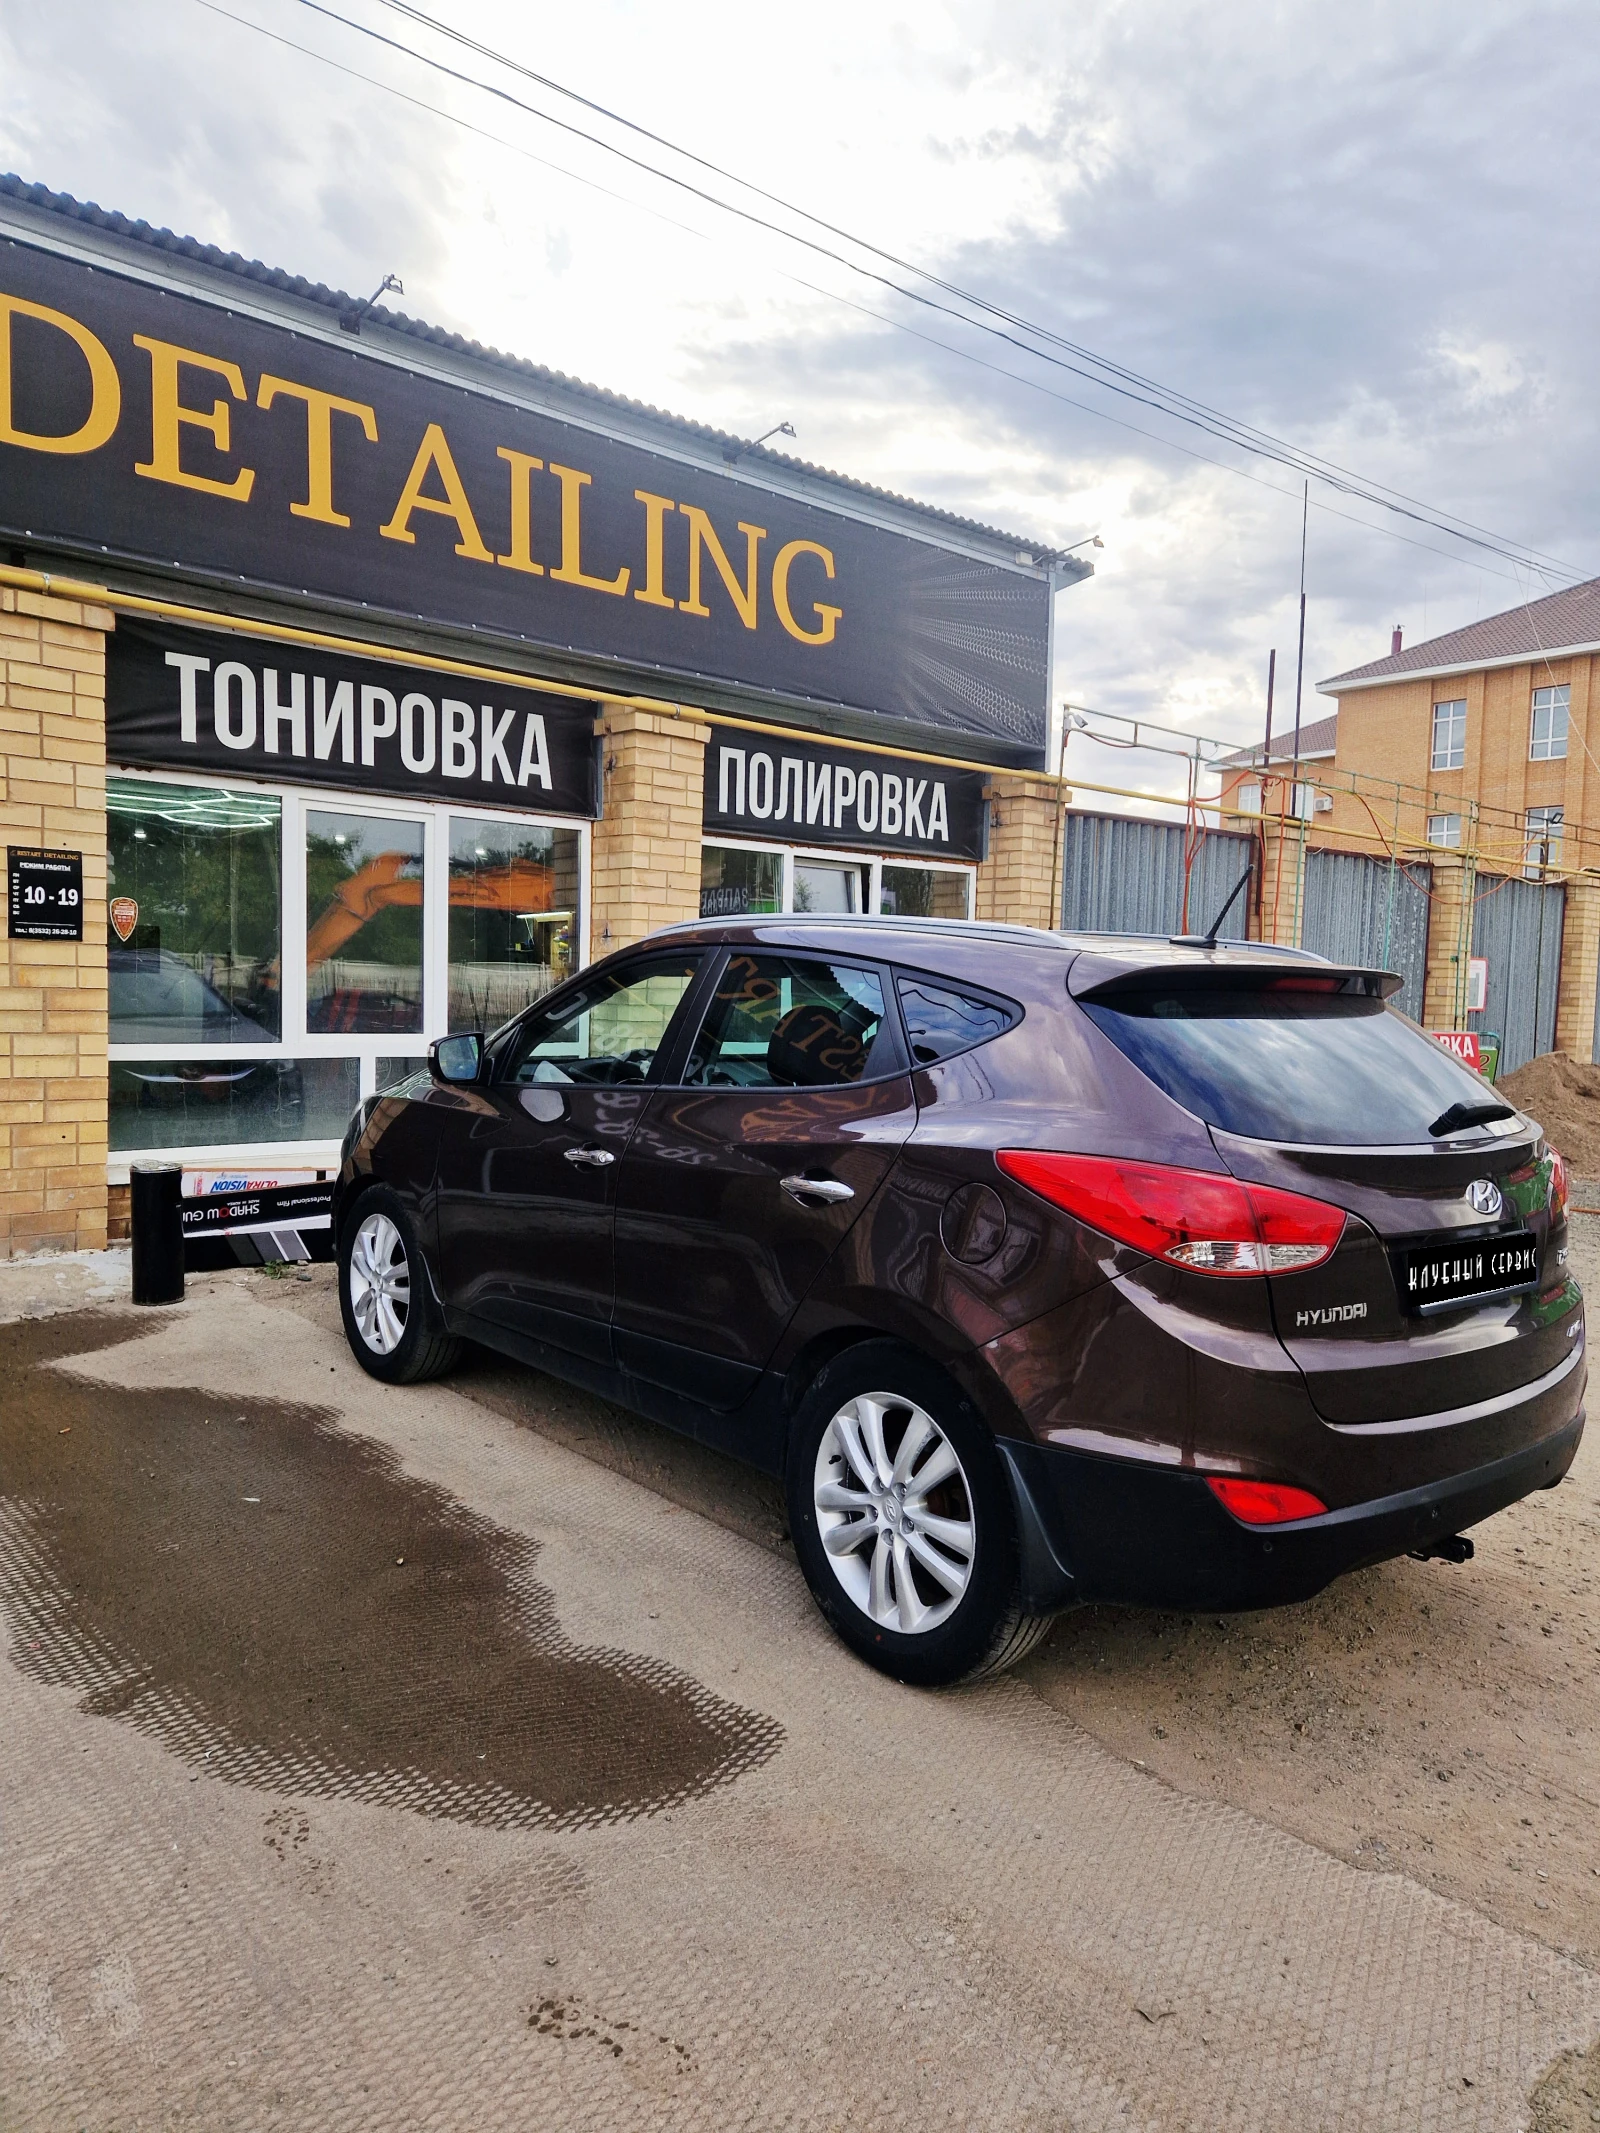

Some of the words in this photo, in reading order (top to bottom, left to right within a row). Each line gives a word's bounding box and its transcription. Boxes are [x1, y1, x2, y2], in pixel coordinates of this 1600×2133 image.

[0, 293, 842, 645] DETAILING
[165, 651, 554, 791] ТОНИРОВКА
[719, 745, 950, 842] ПОЛИРОВКА
[20, 862, 45, 870] РЕЖИМ
[44, 852, 79, 860] DETAILING
[24, 885, 46, 904] 10
[58, 888, 79, 906] 19
[291, 1195, 332, 1206] Professional
[207, 1203, 260, 1220] SHADOW
[1296, 1302, 1368, 1327] HYUNDAI
